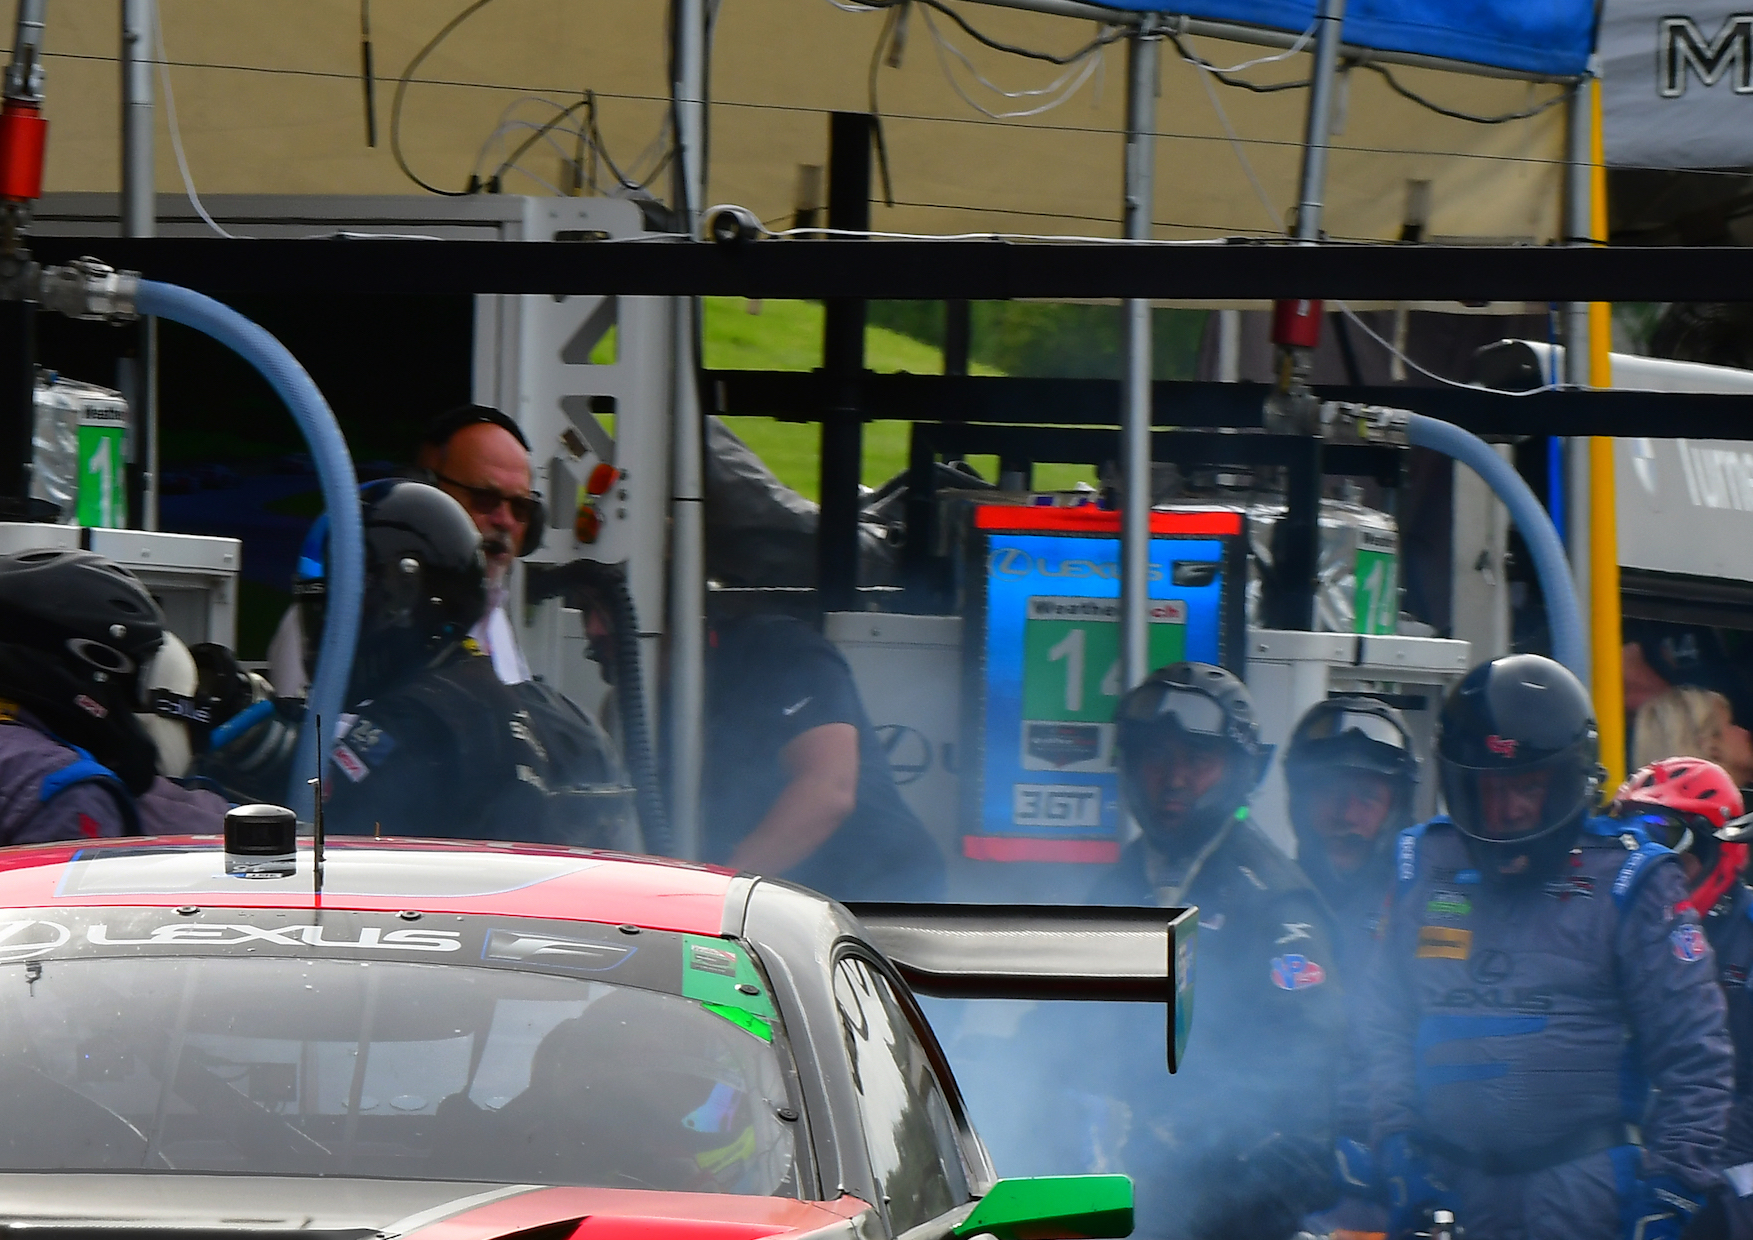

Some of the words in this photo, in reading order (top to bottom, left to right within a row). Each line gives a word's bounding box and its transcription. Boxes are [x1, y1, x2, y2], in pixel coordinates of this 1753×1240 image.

[1657, 13, 1753, 98] M
[1035, 559, 1183, 581] LEXS
[1048, 628, 1121, 711] 1
[1016, 780, 1094, 810] 3GT
[88, 922, 464, 952] LEXUS
